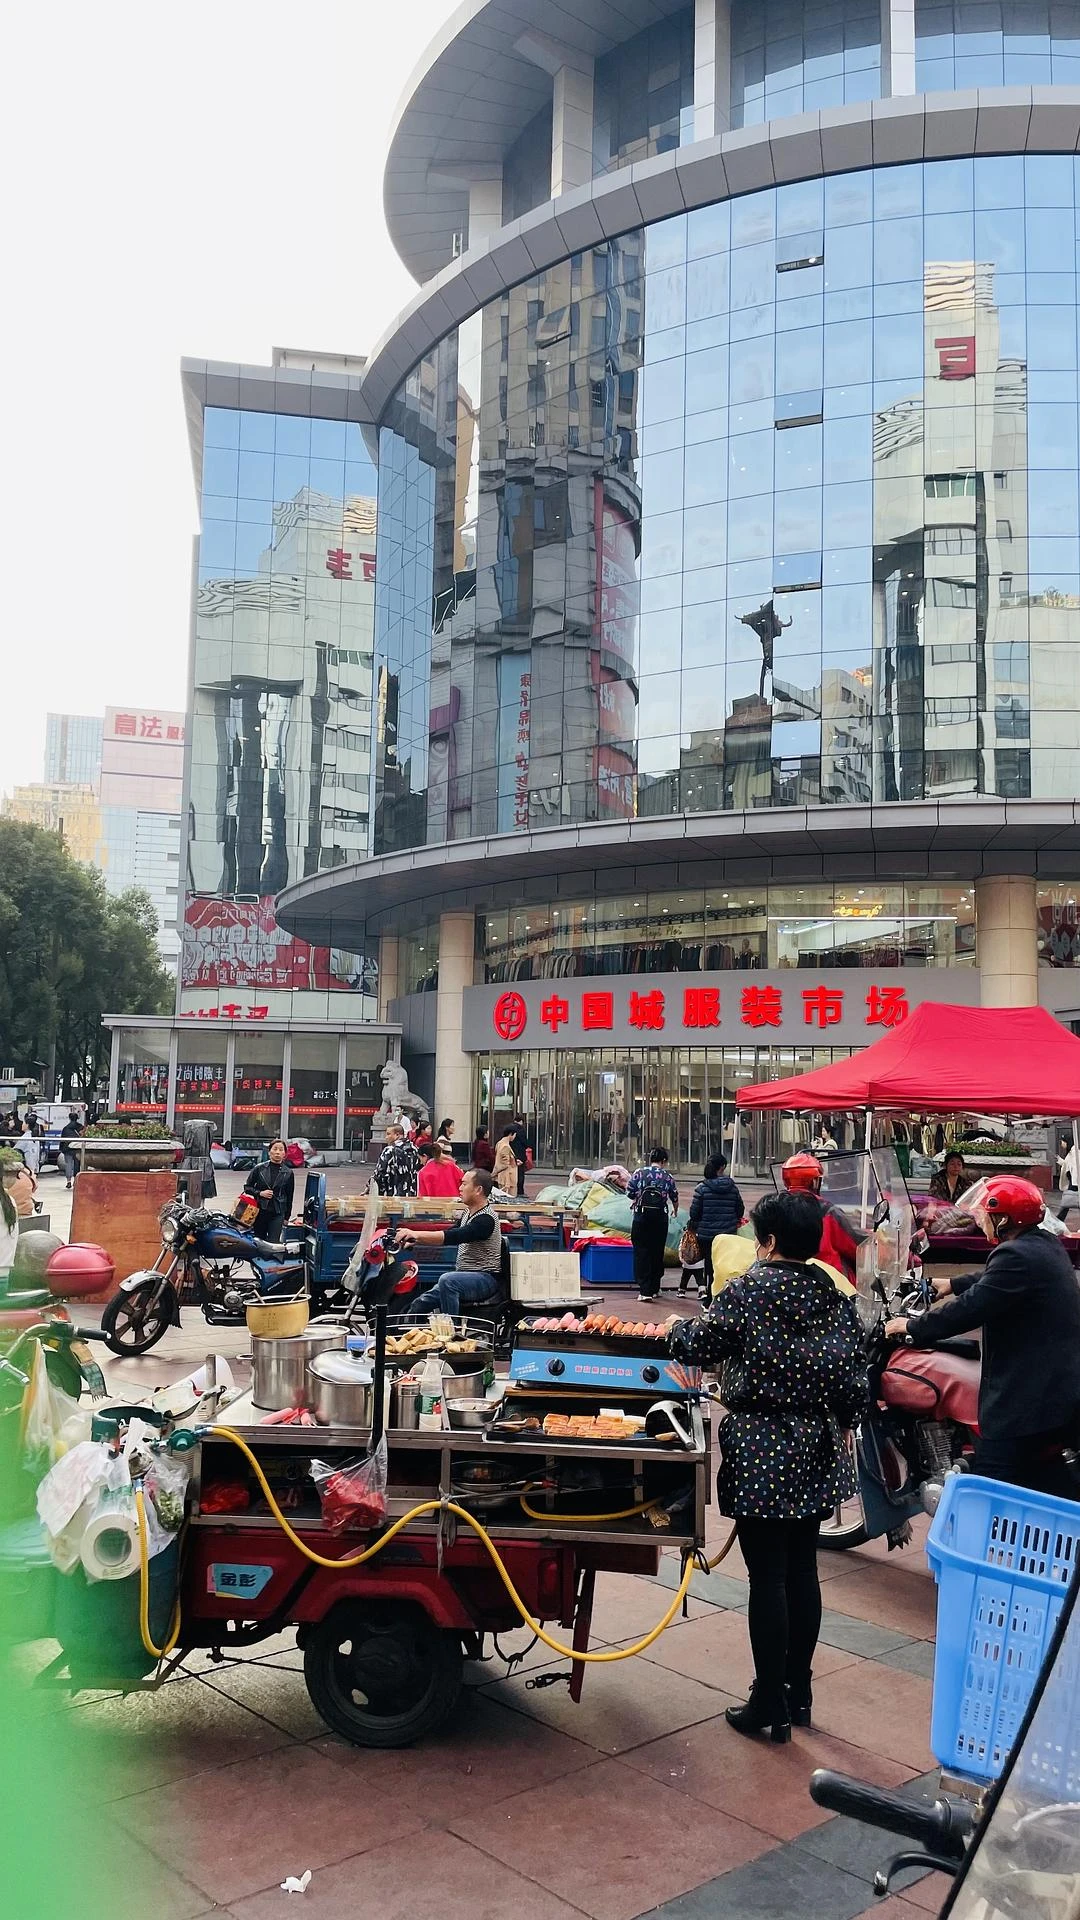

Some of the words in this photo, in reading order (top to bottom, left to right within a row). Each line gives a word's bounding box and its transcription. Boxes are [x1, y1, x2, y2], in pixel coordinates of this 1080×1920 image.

[540, 985, 909, 1033] 中国城服装市场
[220, 1572, 257, 1587] 金彭
